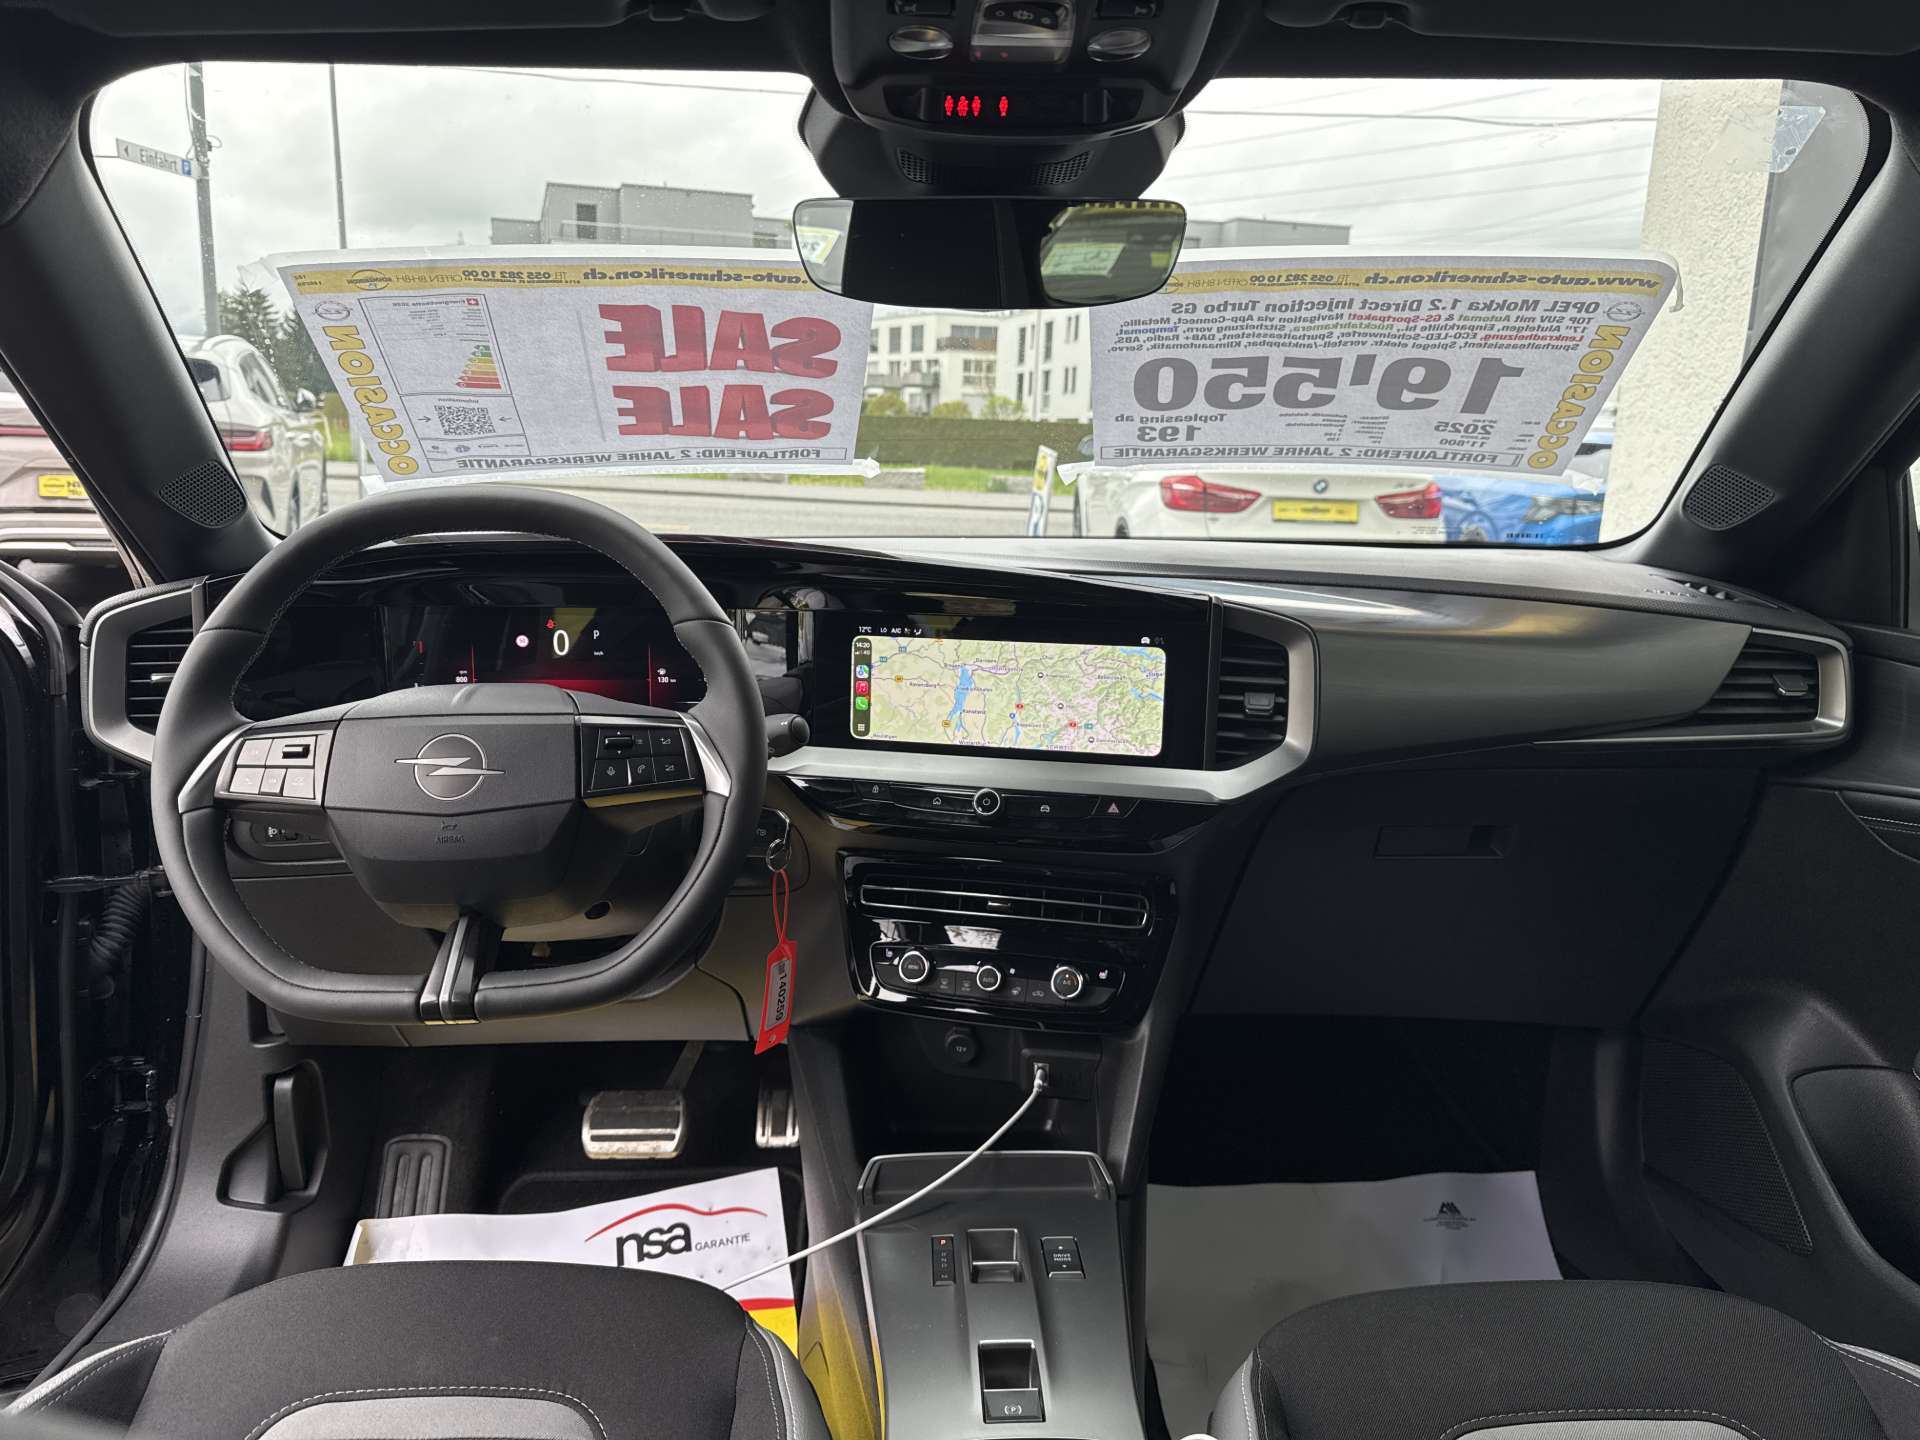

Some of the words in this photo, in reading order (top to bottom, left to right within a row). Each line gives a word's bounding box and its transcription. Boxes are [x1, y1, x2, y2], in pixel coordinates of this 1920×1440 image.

[139, 148, 177, 172] Einfahrt
[553, 629, 570, 656] 0
[593, 630, 600, 640] P
[455, 675, 468, 683] 800
[616, 1222, 692, 1267] nsa
[695, 1233, 751, 1252] GARANTIE
